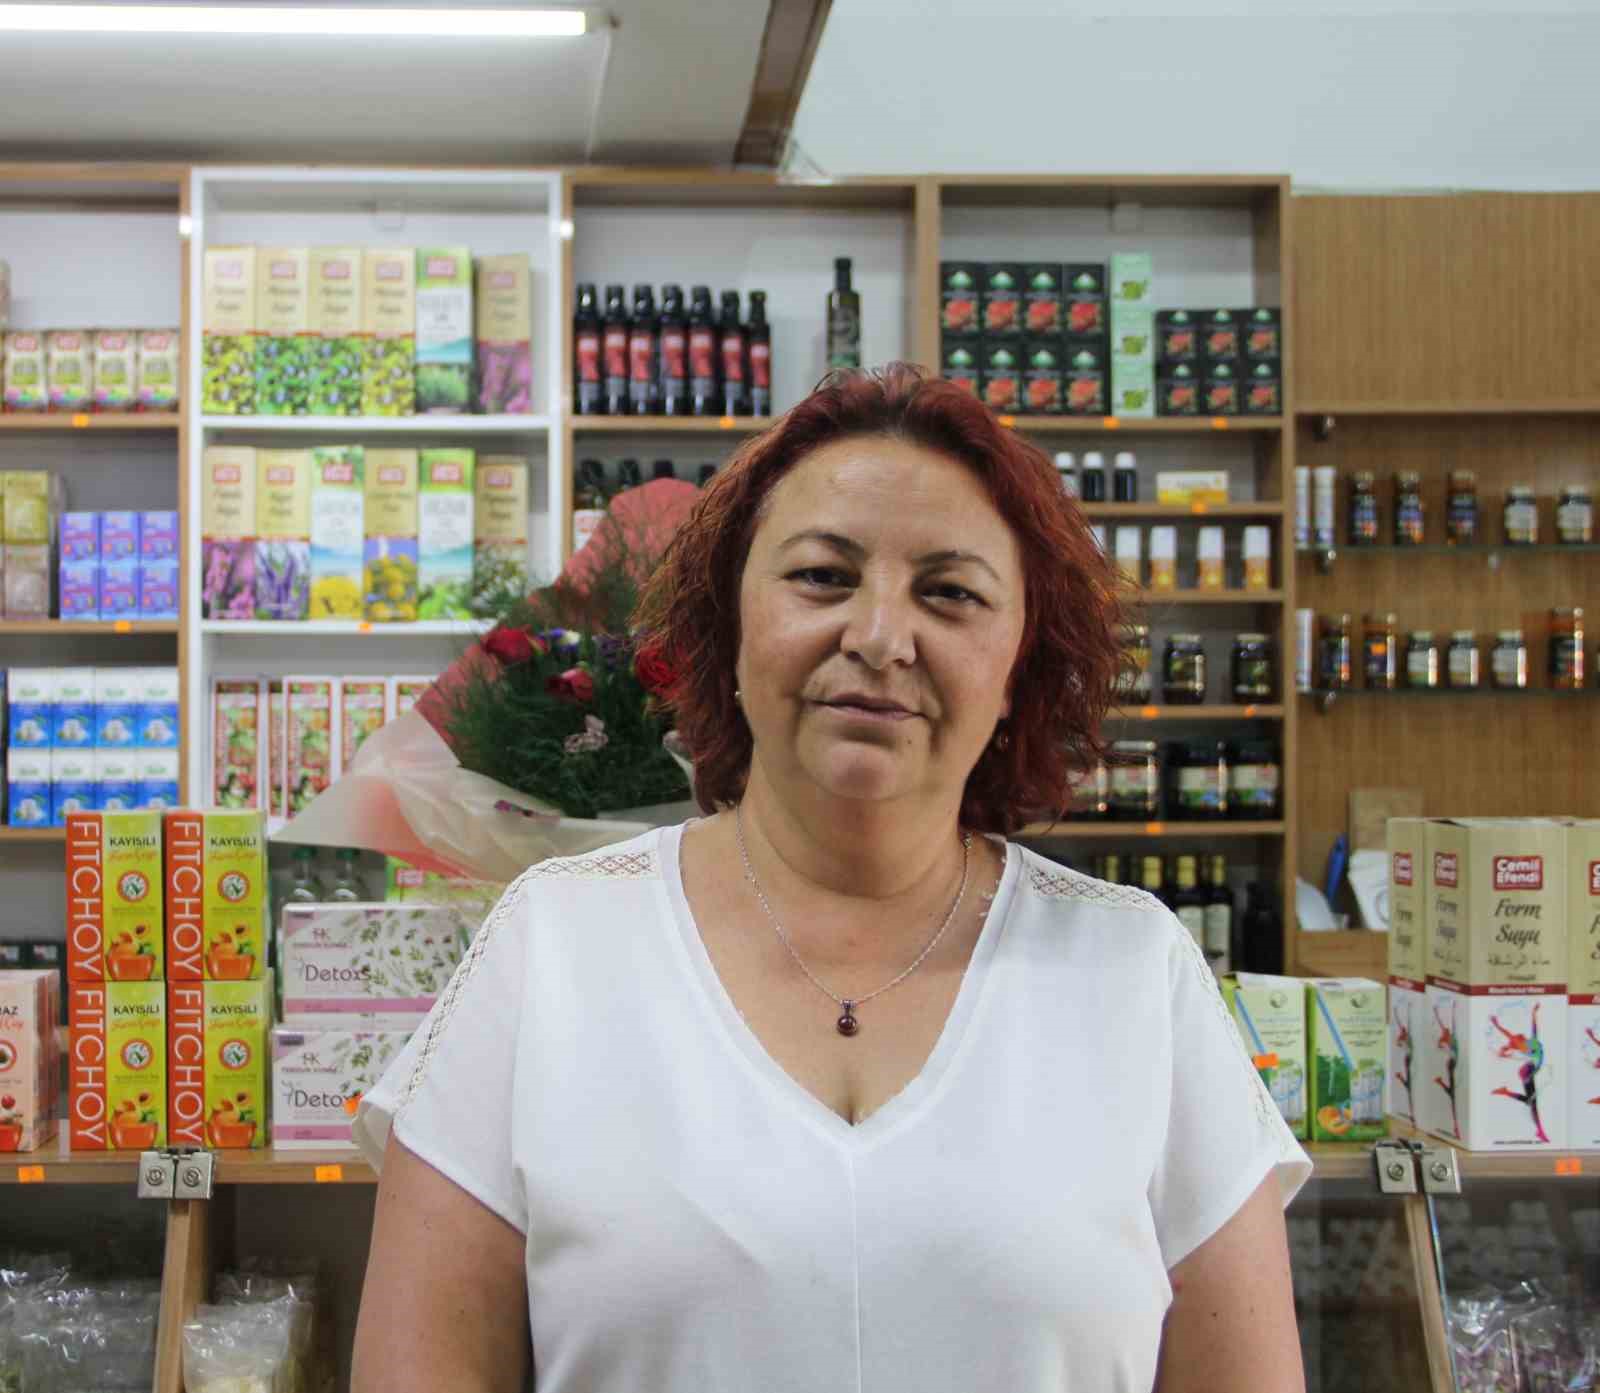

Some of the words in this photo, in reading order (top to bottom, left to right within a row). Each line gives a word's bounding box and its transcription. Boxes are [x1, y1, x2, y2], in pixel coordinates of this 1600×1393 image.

[73, 821, 101, 975] FITCHOY
[173, 822, 201, 975] FITCHOY
[1494, 898, 1542, 919] Form
[1497, 859, 1541, 872] Cemil
[1497, 871, 1540, 884] Efendi
[1496, 923, 1541, 950] Suyu
[76, 989, 104, 1143] FITCHOY
[175, 989, 202, 1142] FITCHOY
